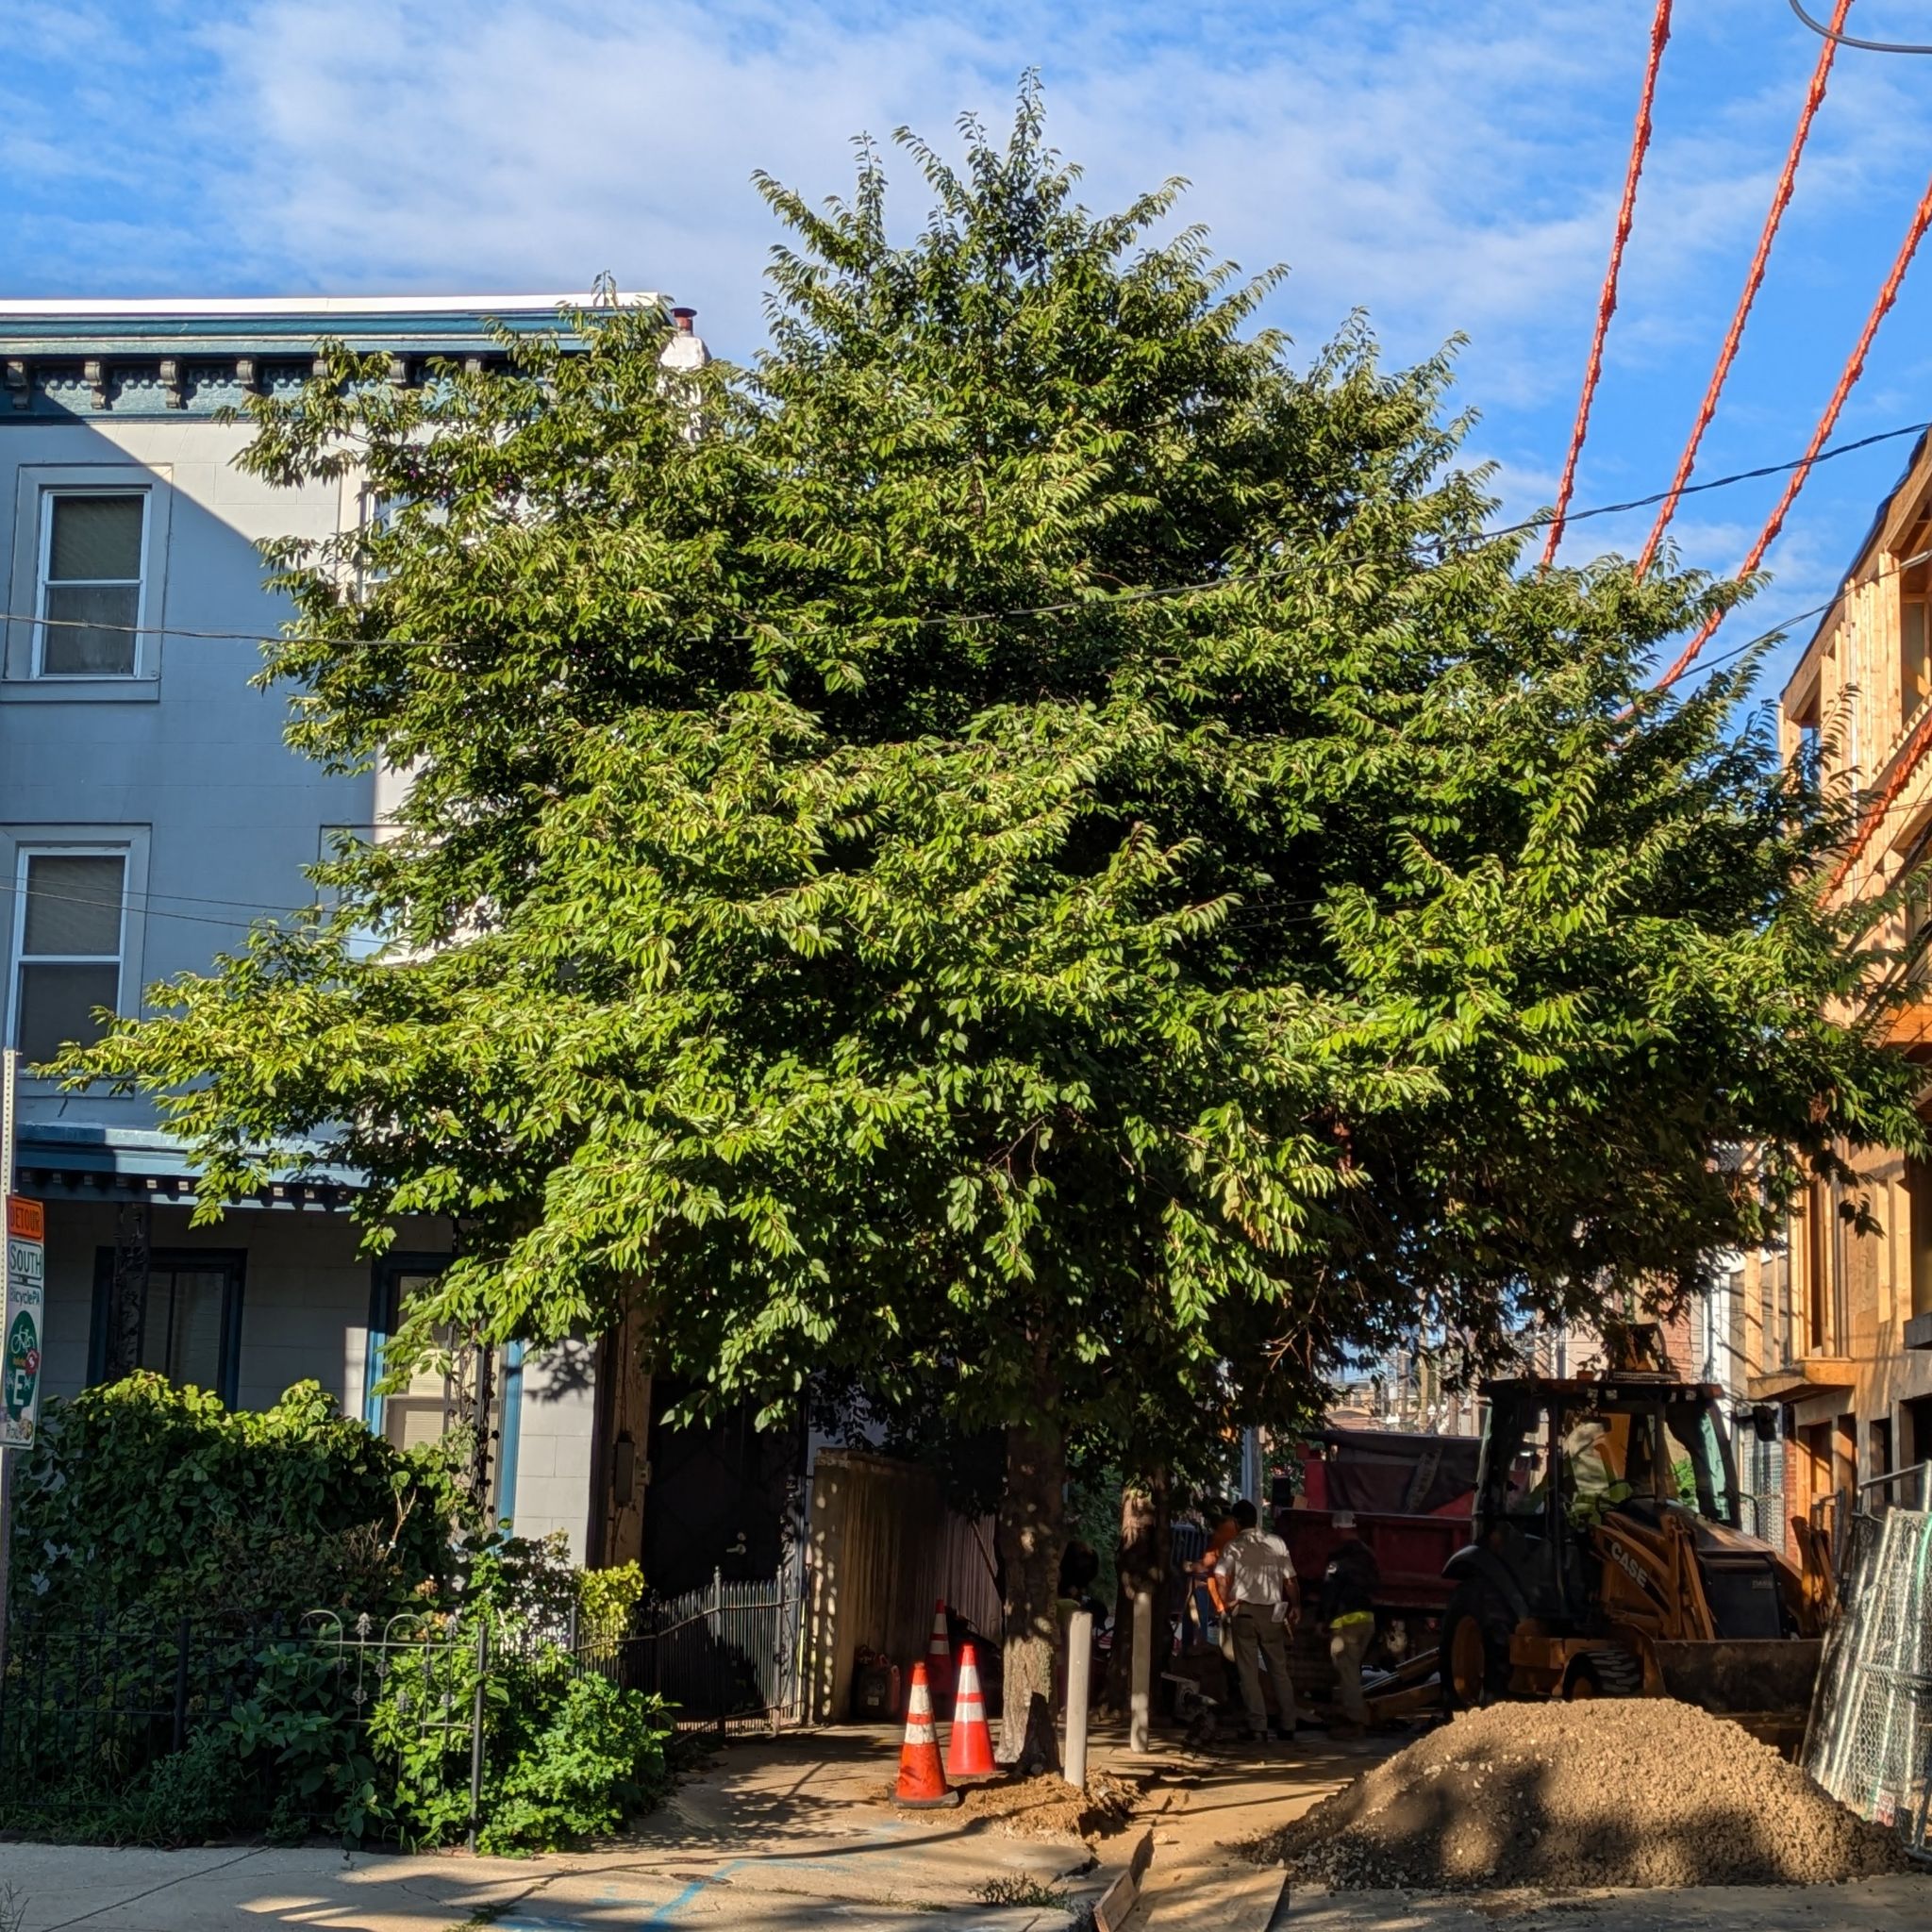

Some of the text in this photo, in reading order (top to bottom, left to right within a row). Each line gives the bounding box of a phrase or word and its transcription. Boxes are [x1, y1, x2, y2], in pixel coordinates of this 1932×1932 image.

[9, 1205, 40, 1232] DETOUR
[9, 1243, 42, 1275] SOUTH
[13, 1368, 26, 1406] E
[1611, 1541, 1648, 1588] CASE
